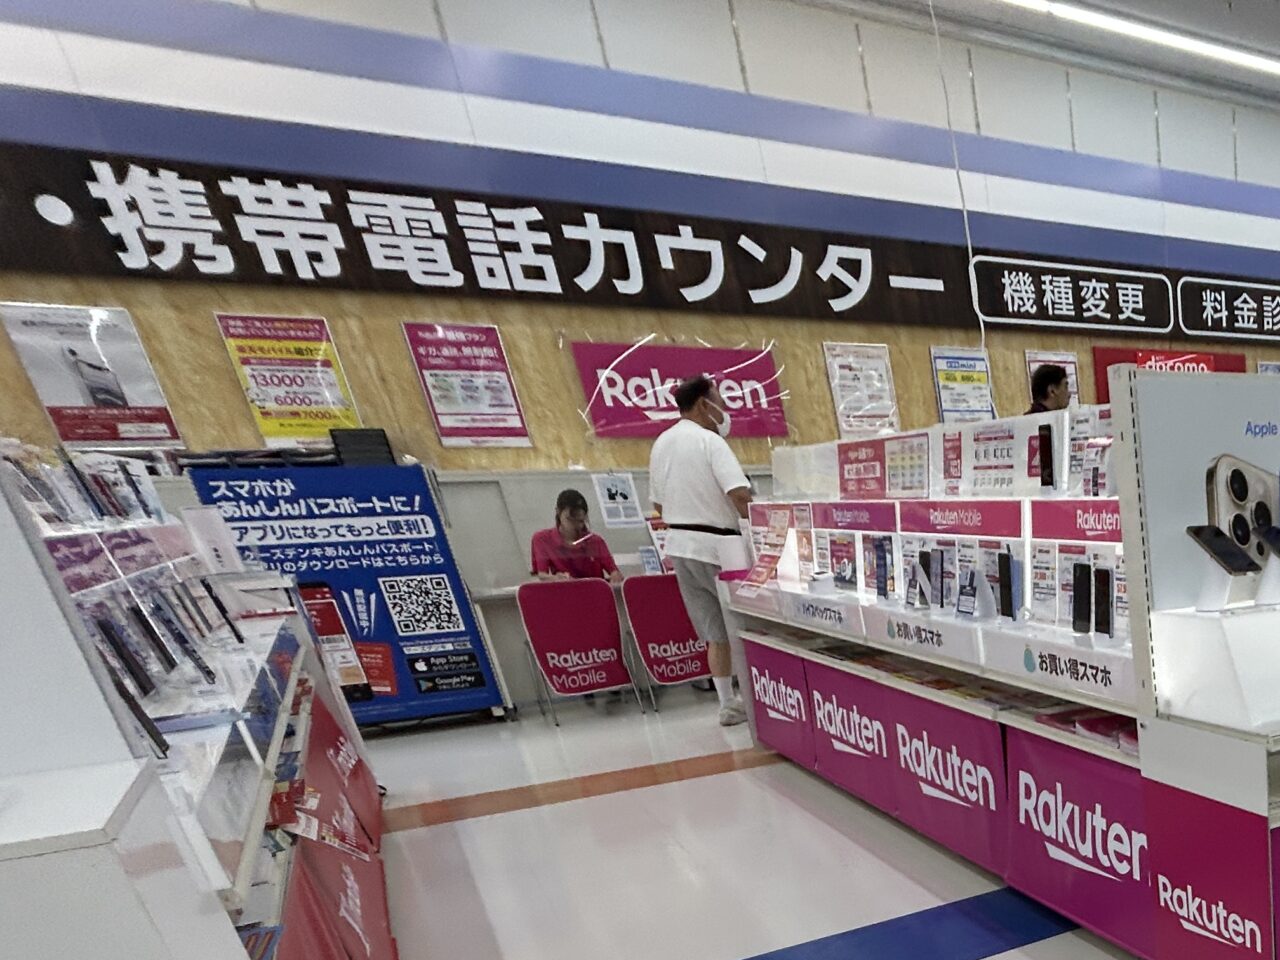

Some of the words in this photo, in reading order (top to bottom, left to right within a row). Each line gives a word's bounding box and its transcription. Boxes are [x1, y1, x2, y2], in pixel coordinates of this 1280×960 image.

[85, 160, 945, 313] 携帯電話カウンター
[1001, 270, 1147, 322] 機種変更
[596, 368, 769, 409] Raken
[1245, 421, 1278, 437] Apple
[208, 478, 296, 498] スマホが
[929, 508, 959, 525] Rakuten
[1076, 508, 1120, 530] Rakuten
[896, 621, 944, 647] お買い得スマホ
[546, 648, 618, 669] Rakuten
[652, 659, 702, 679] Mobile
[1038, 651, 1113, 688] お買い得スマホ
[552, 669, 608, 690] Mobile
[751, 666, 806, 723] Rakuten
[811, 689, 888, 758] Rakuten
[895, 723, 996, 812] Rakuten
[1157, 873, 1262, 954] Rakuten
